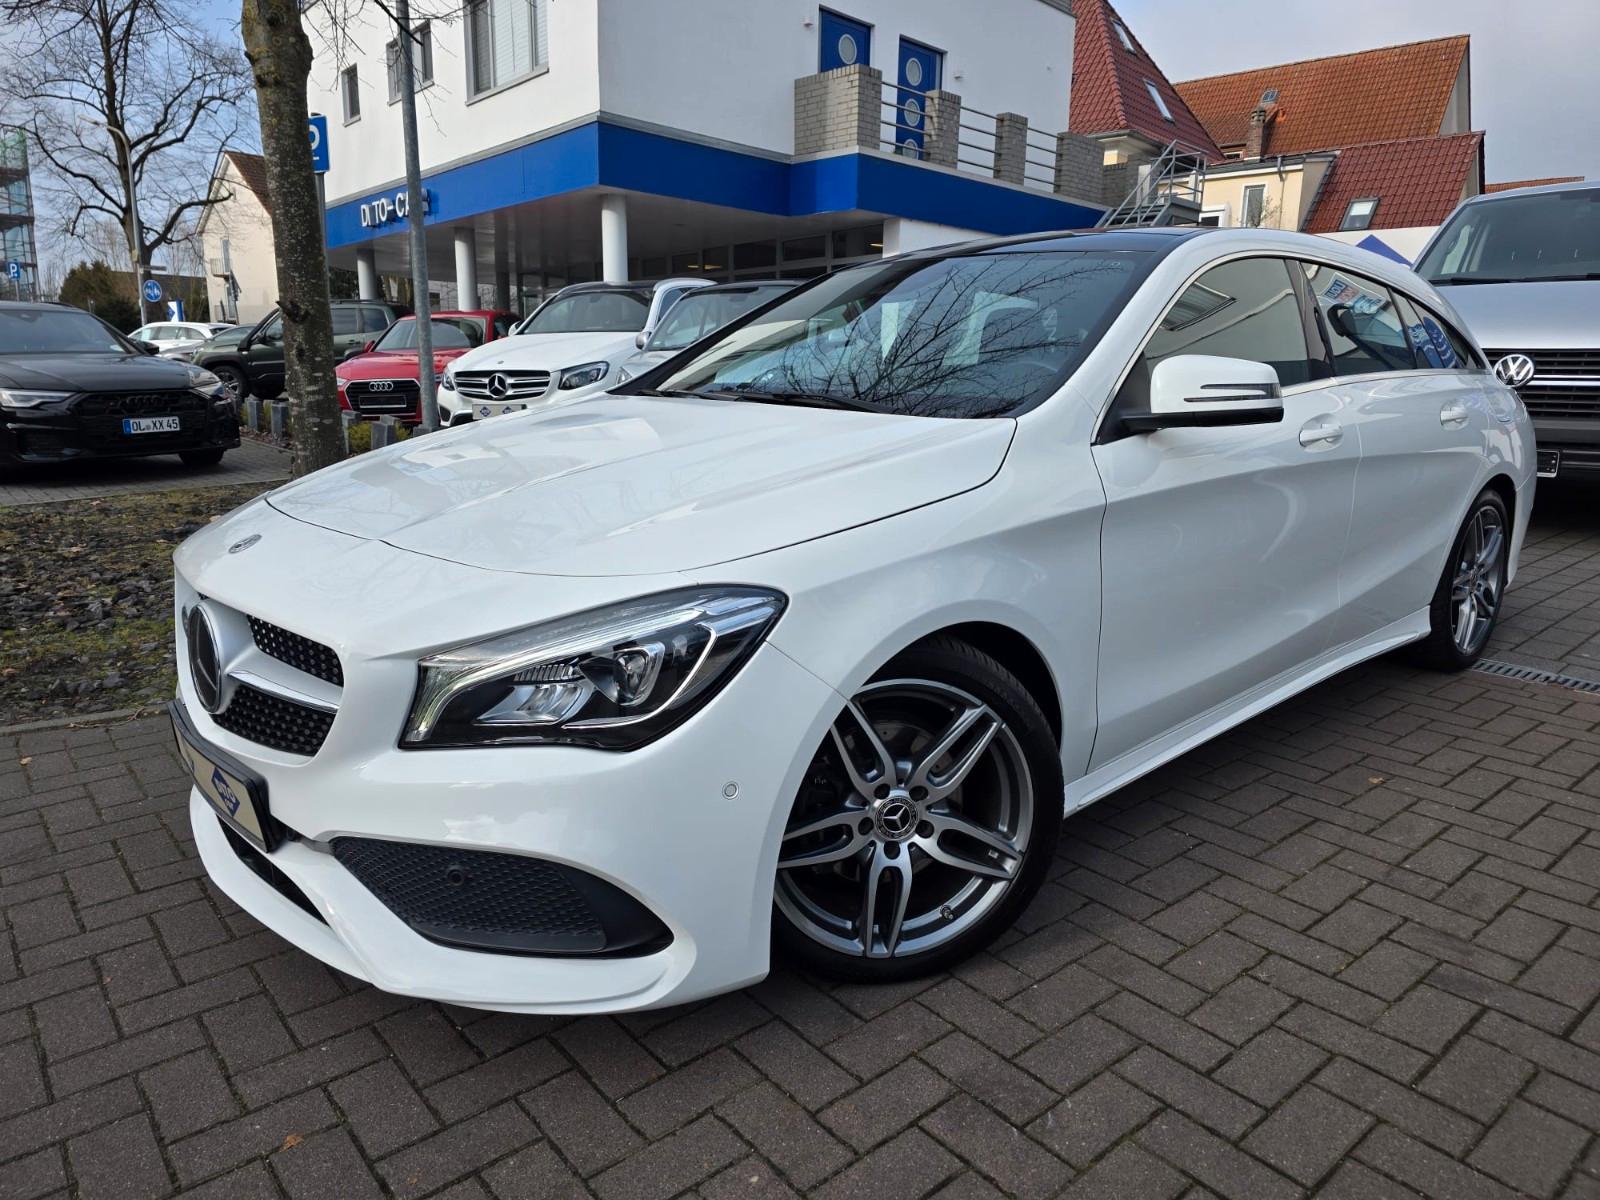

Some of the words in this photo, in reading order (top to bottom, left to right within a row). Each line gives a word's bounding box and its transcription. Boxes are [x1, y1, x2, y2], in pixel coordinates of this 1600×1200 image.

[10, 263, 17, 277] P
[132, 421, 145, 431] OL
[152, 420, 164, 430] XX
[167, 418, 178, 429] 45
